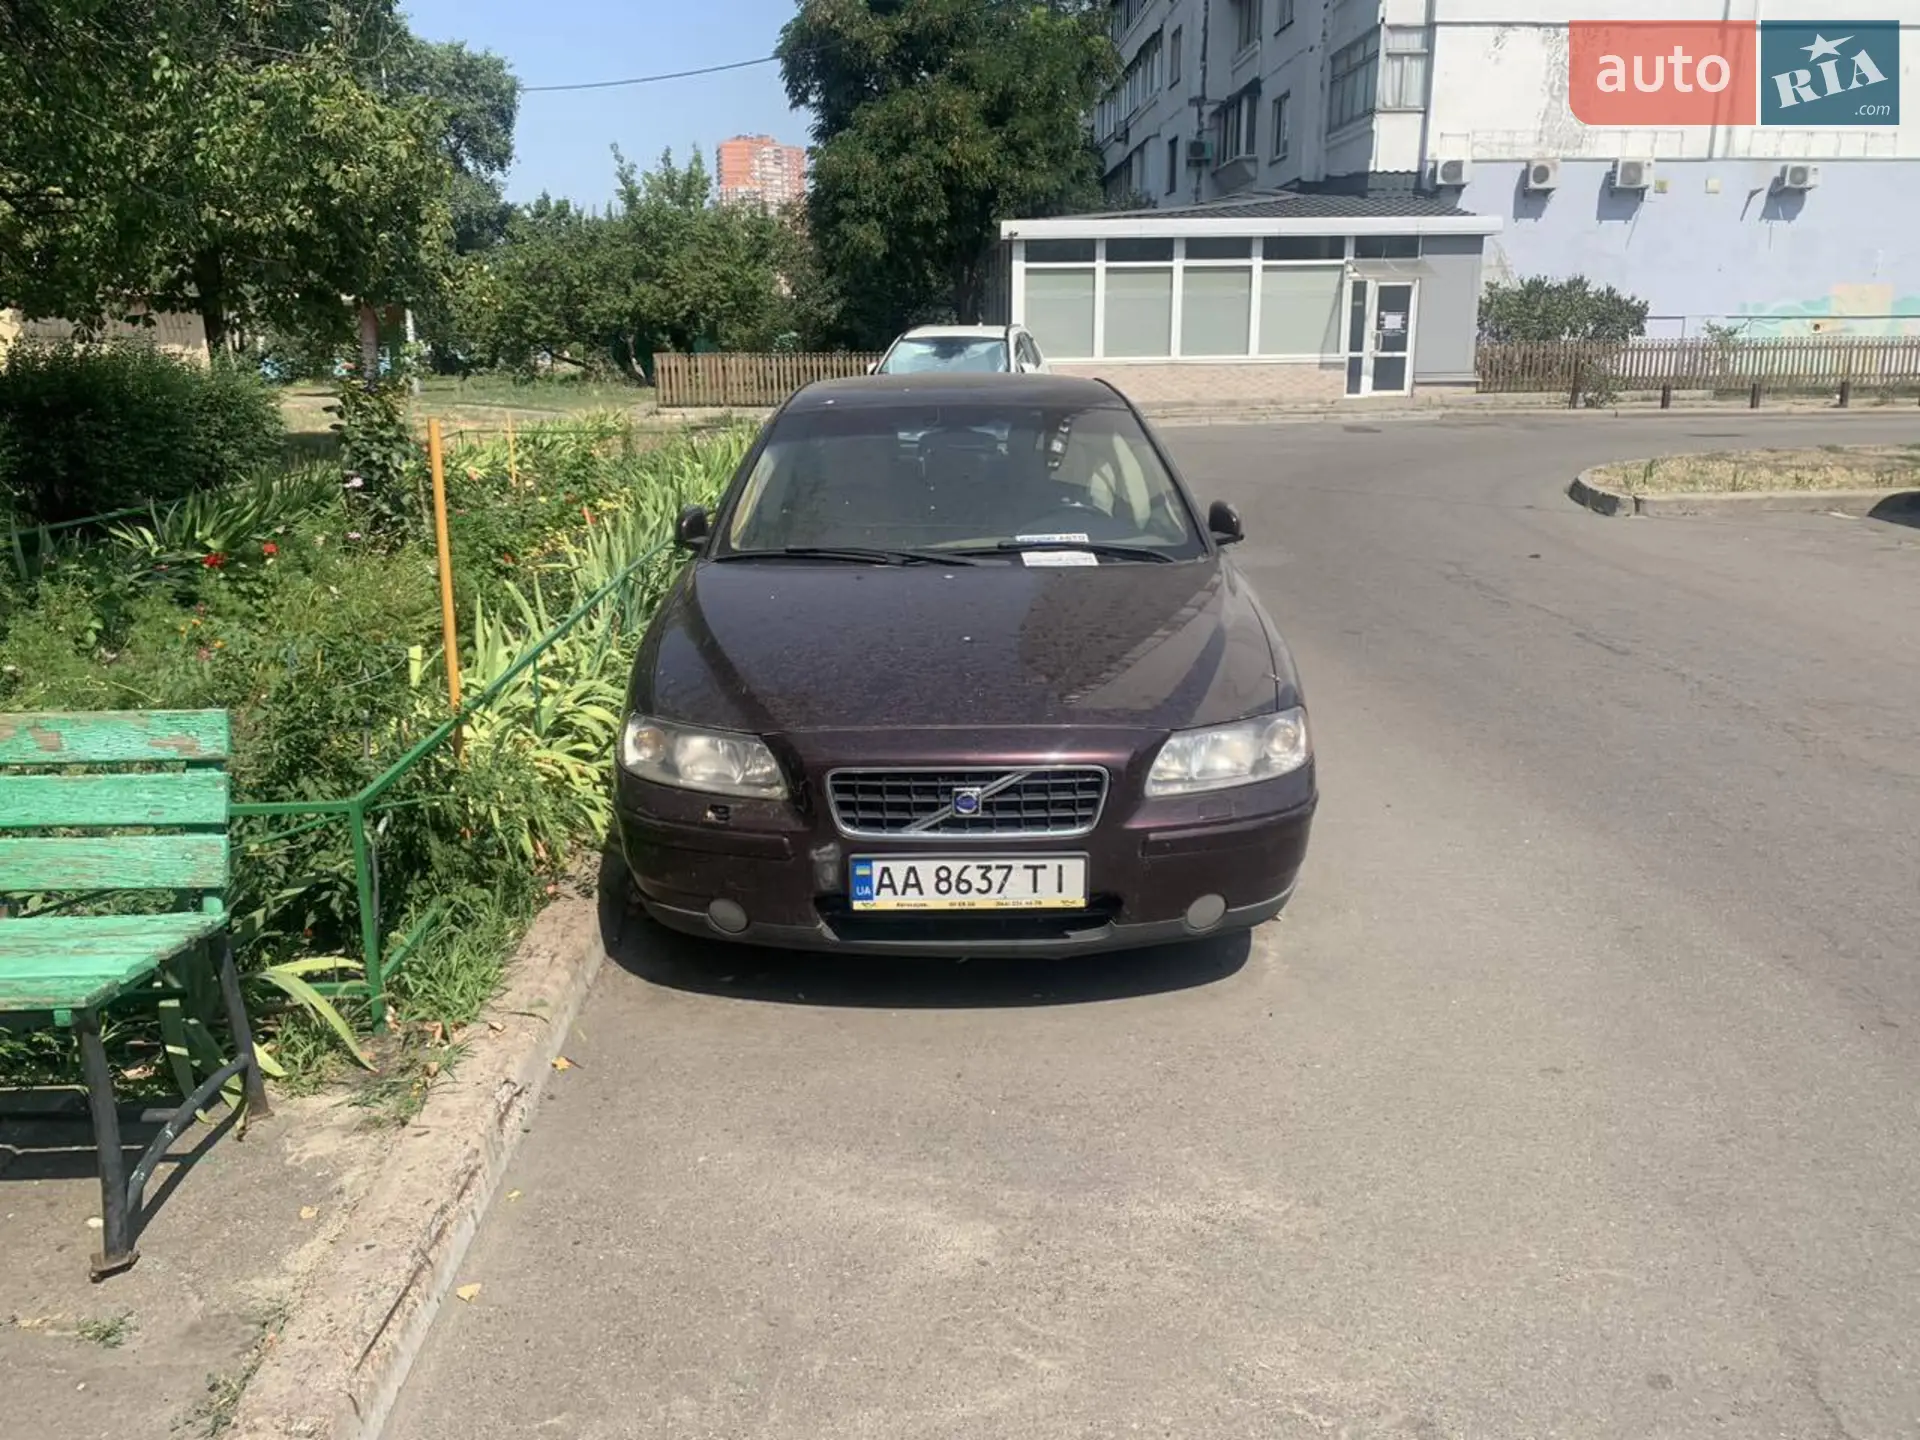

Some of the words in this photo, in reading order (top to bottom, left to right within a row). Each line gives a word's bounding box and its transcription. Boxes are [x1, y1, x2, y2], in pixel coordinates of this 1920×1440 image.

[875, 865, 924, 896] AA
[934, 865, 1013, 895] 8637
[1023, 864, 1063, 894] TI
[856, 886, 871, 896] UA
